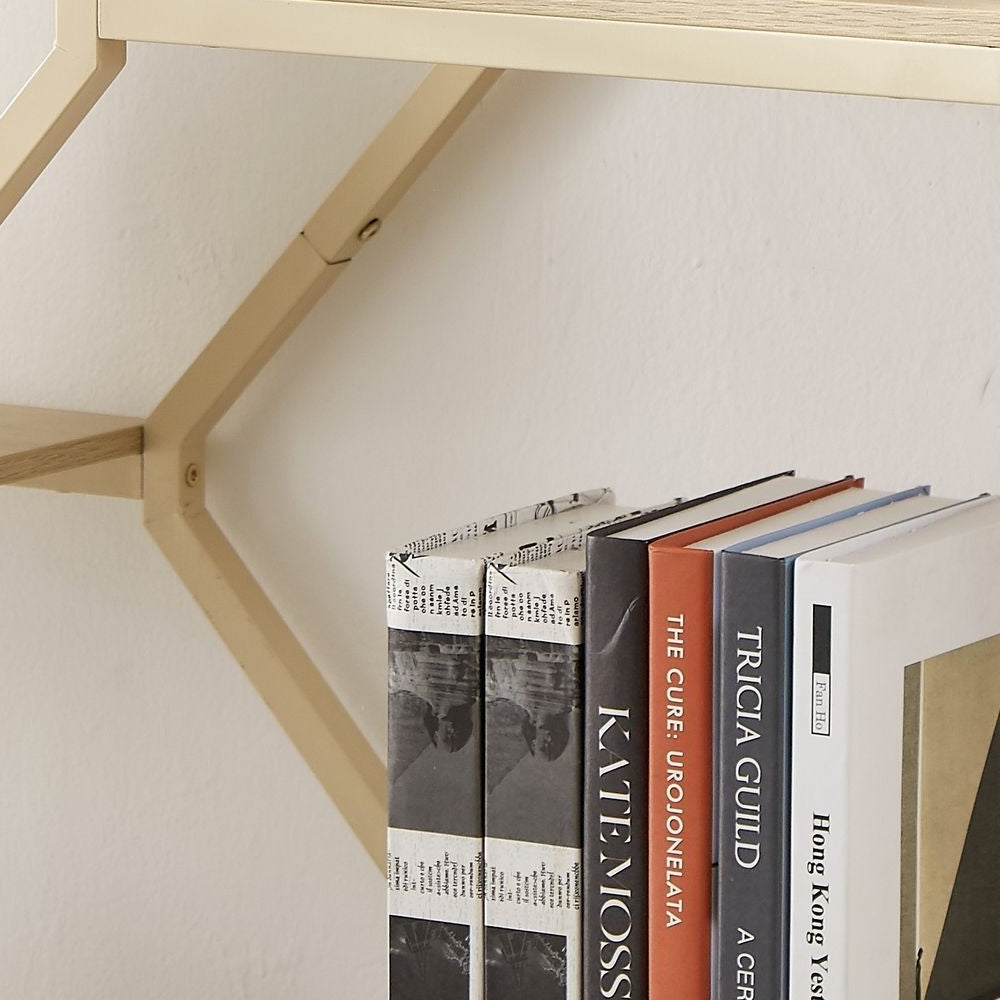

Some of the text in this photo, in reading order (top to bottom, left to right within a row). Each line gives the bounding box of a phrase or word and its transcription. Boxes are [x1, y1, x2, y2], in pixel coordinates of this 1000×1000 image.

[815, 681, 827, 730] Fan Ho
[667, 613, 684, 928] THE CURE: UROJONELATA
[735, 625, 763, 869] TRICIA GUILD
[599, 705, 632, 1000] KATE MOSS
[806, 812, 831, 876] Hong
[737, 927, 754, 945] A
[806, 882, 830, 946] Kong
